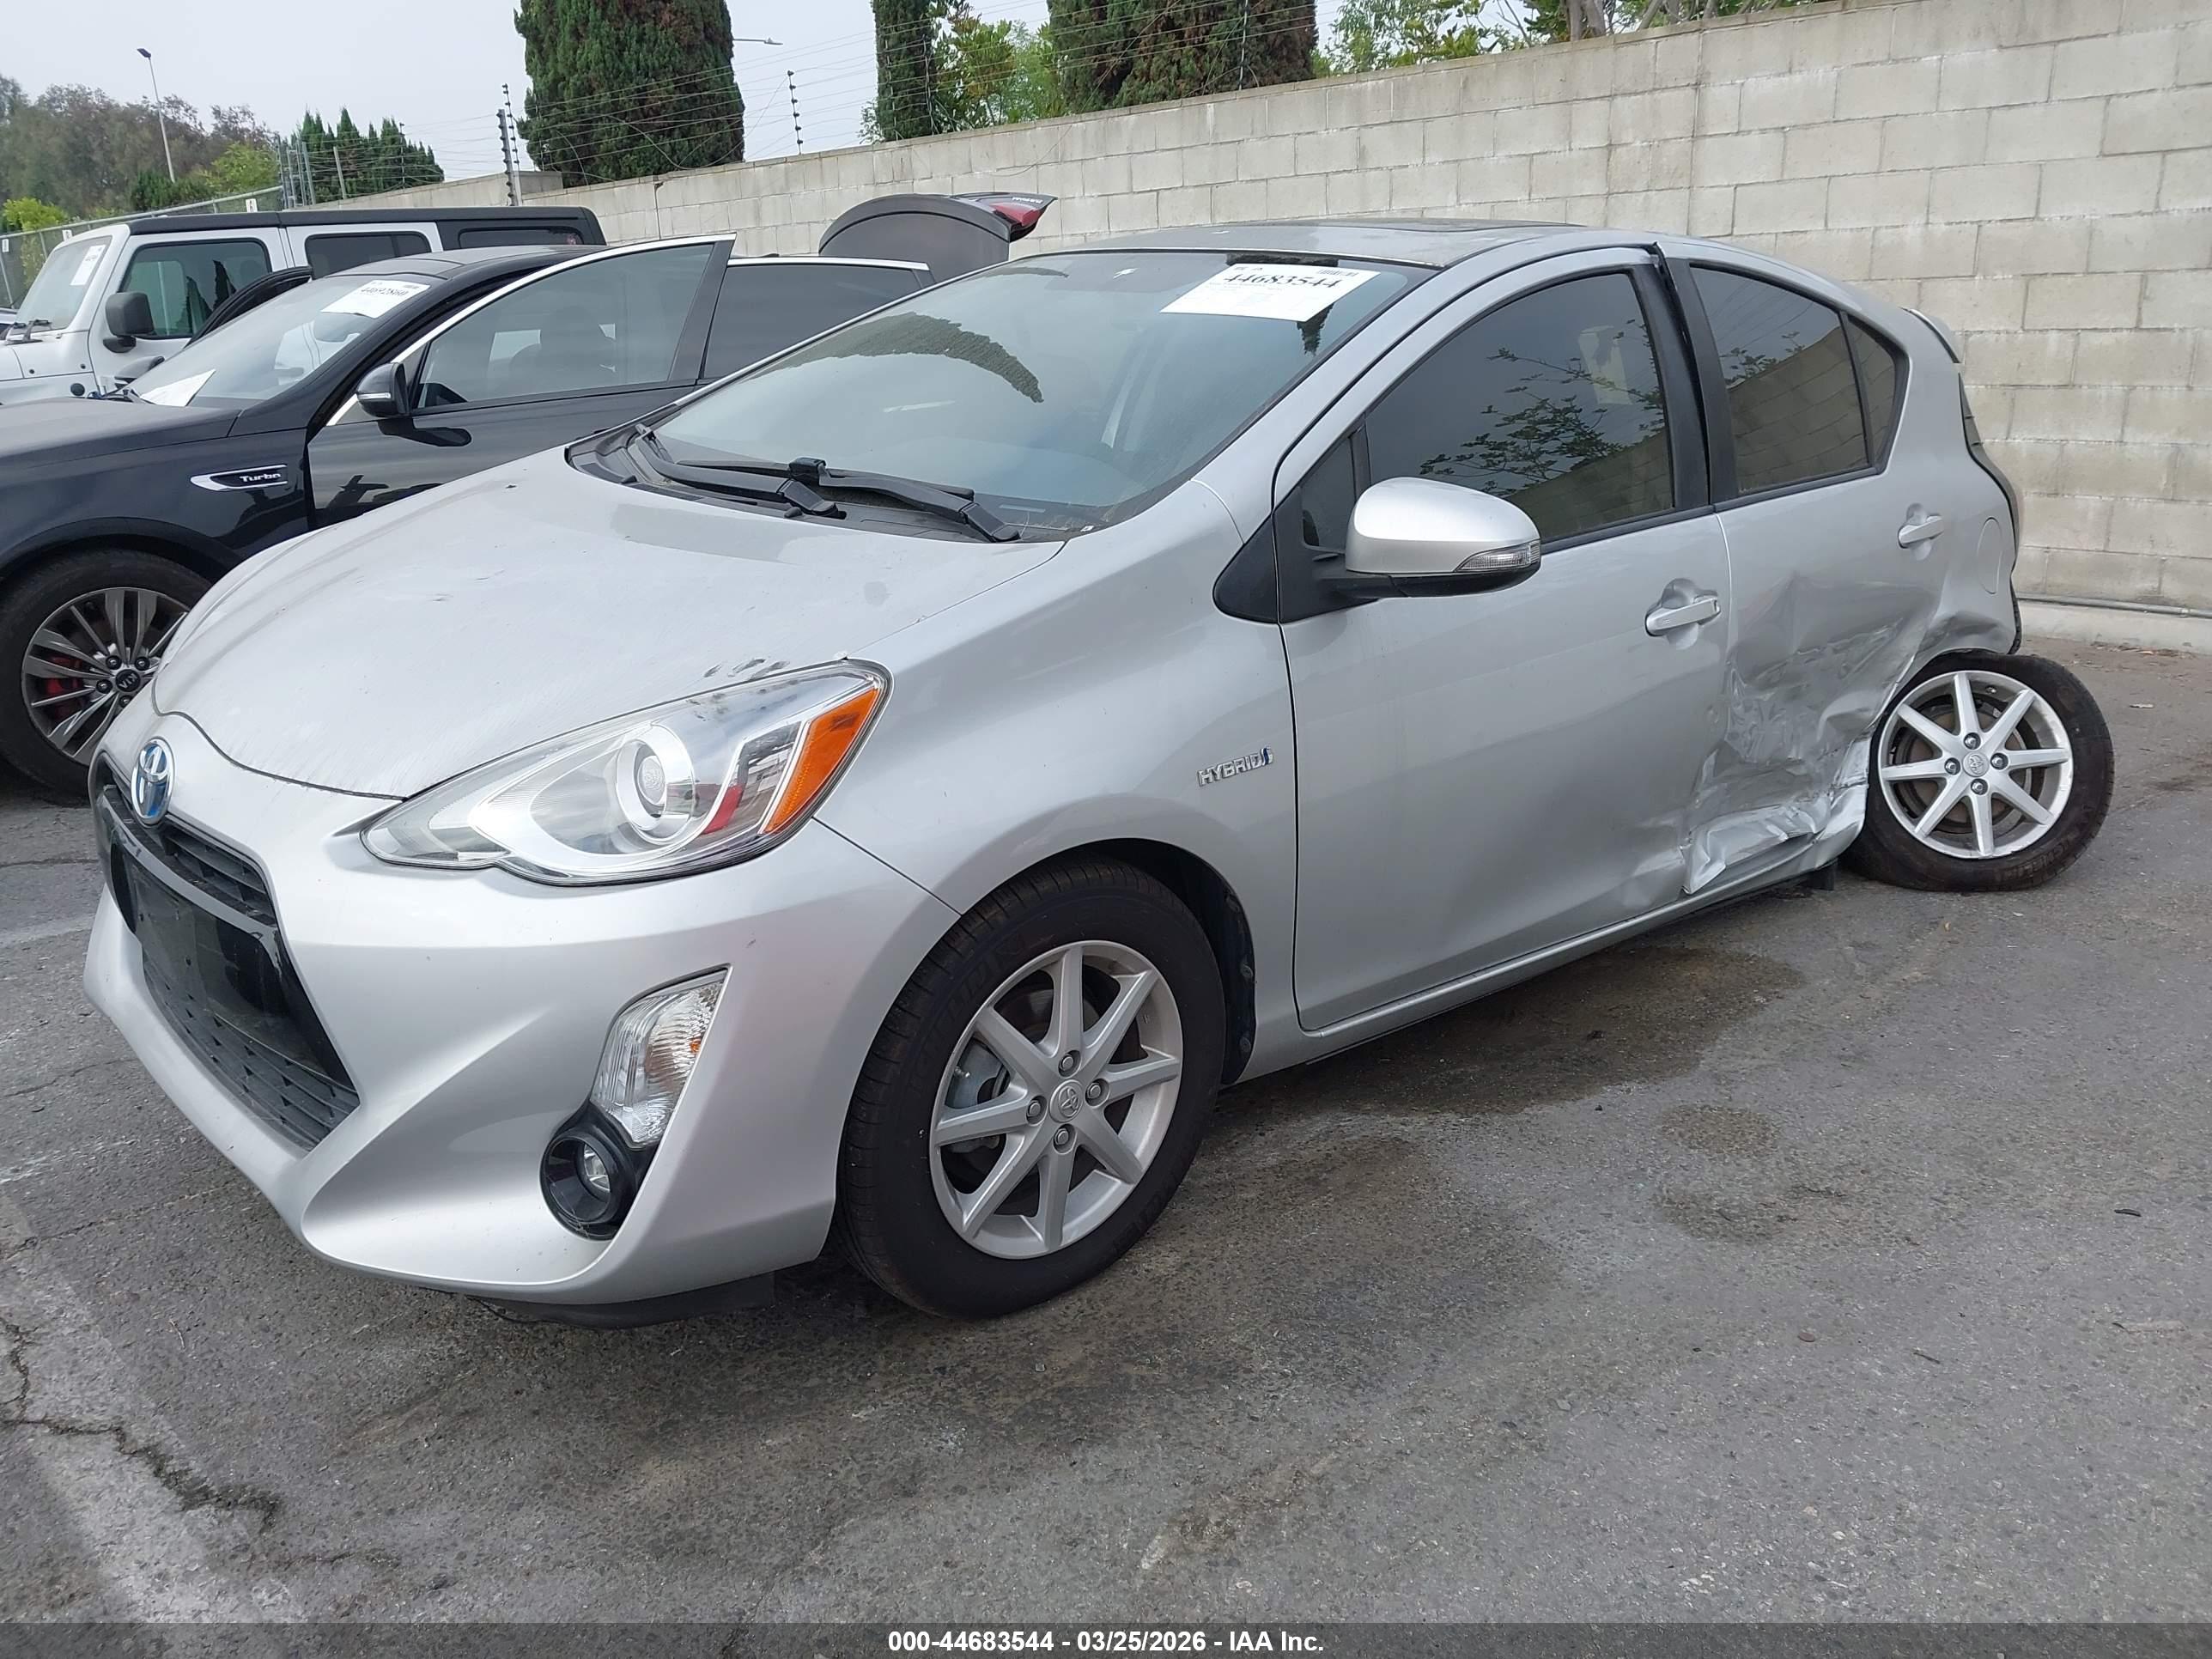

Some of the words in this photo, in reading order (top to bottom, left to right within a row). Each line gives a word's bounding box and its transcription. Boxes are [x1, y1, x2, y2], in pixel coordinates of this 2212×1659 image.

[1224, 273, 1343, 289] 44683544
[239, 473, 282, 483] Turbo
[1197, 752, 1263, 787] HYBRID
